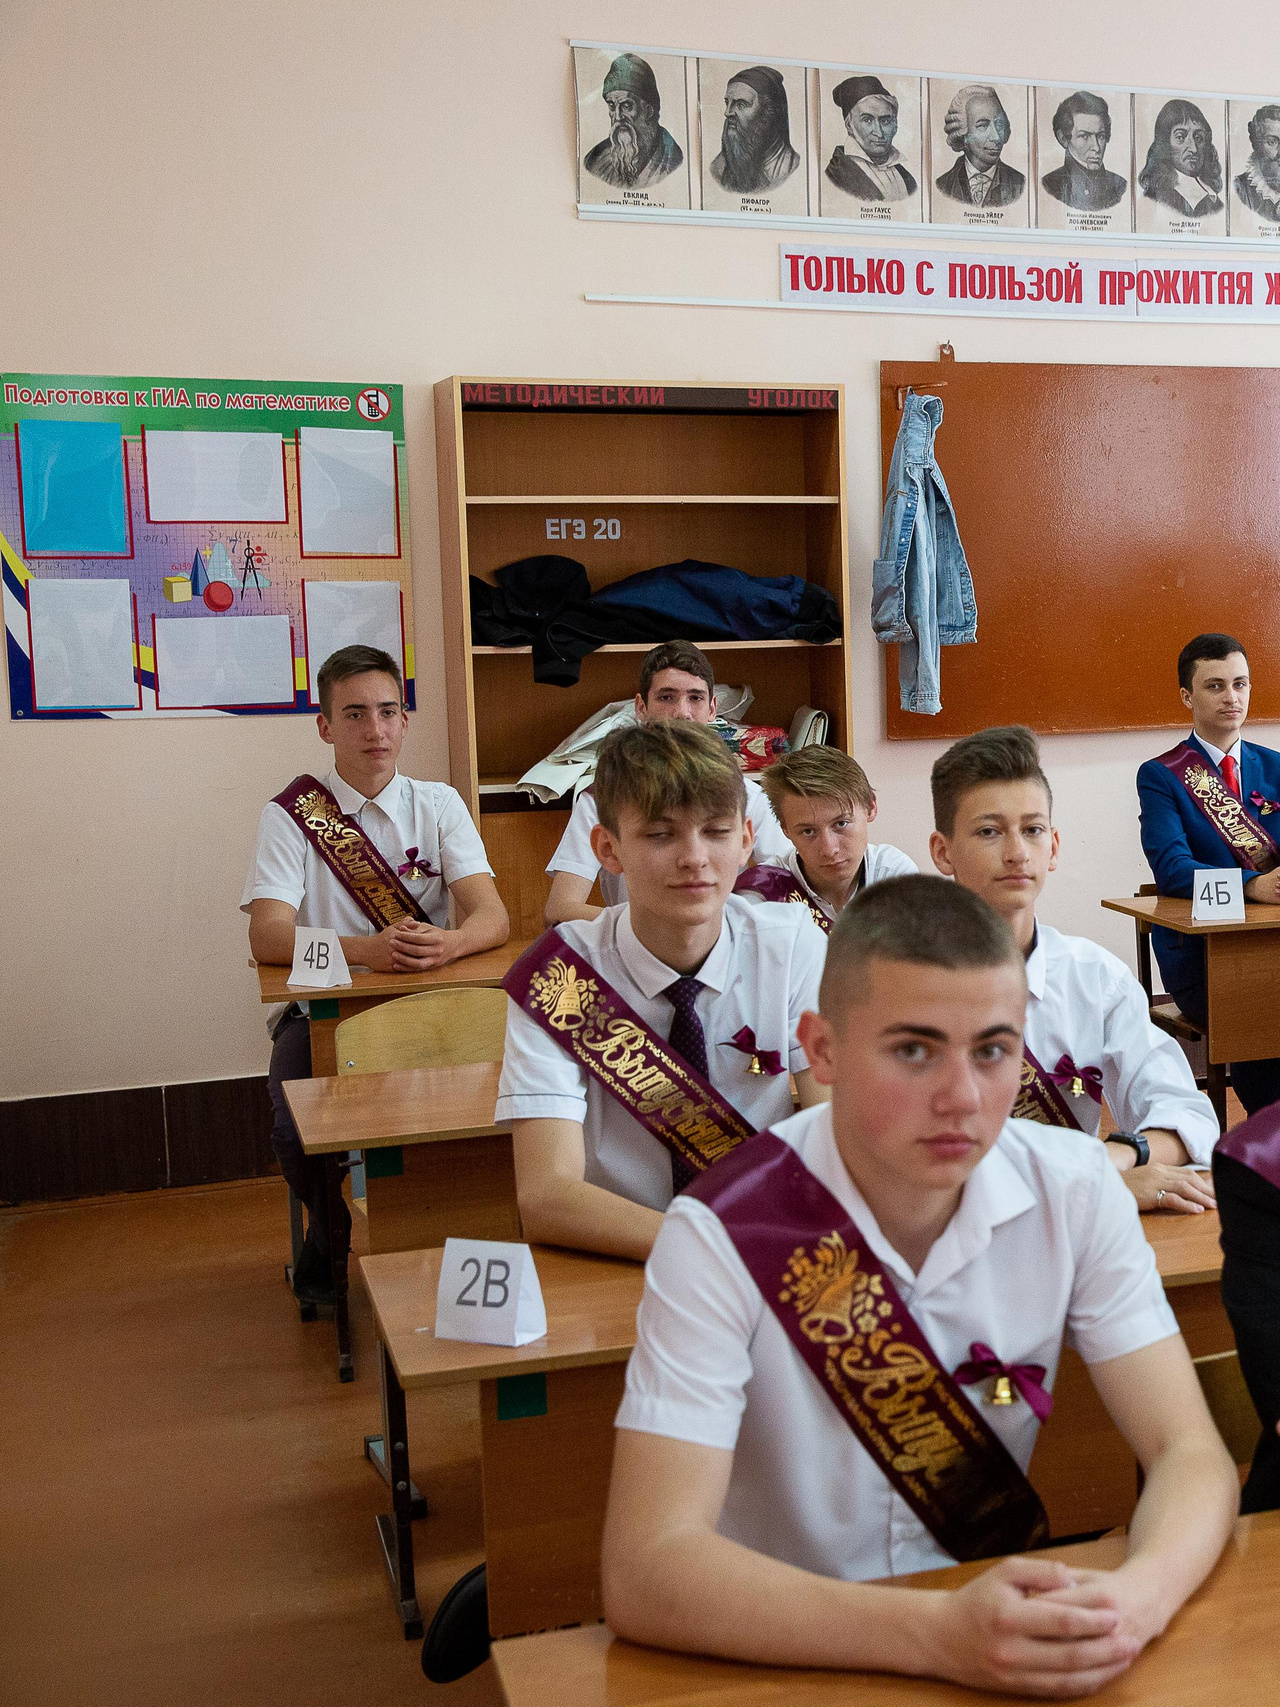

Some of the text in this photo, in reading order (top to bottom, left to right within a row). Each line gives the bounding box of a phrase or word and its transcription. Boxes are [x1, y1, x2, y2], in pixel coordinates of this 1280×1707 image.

[624, 192, 649, 200] ЕВКЛИД
[785, 254, 905, 296] ТОЛЬКО
[916, 261, 934, 296] С
[948, 261, 1083, 304] ПОЛЬЗОЙ
[1099, 269, 1253, 305] ПРОЖИТАЯ
[4, 383, 351, 412] Подготовка к ГИА по математике
[748, 388, 834, 408] УГОЛОК
[545, 518, 621, 540] ЕГЭ 20
[1200, 881, 1231, 906] 4Б
[304, 941, 330, 970] 4В
[456, 1258, 510, 1308] 2В
